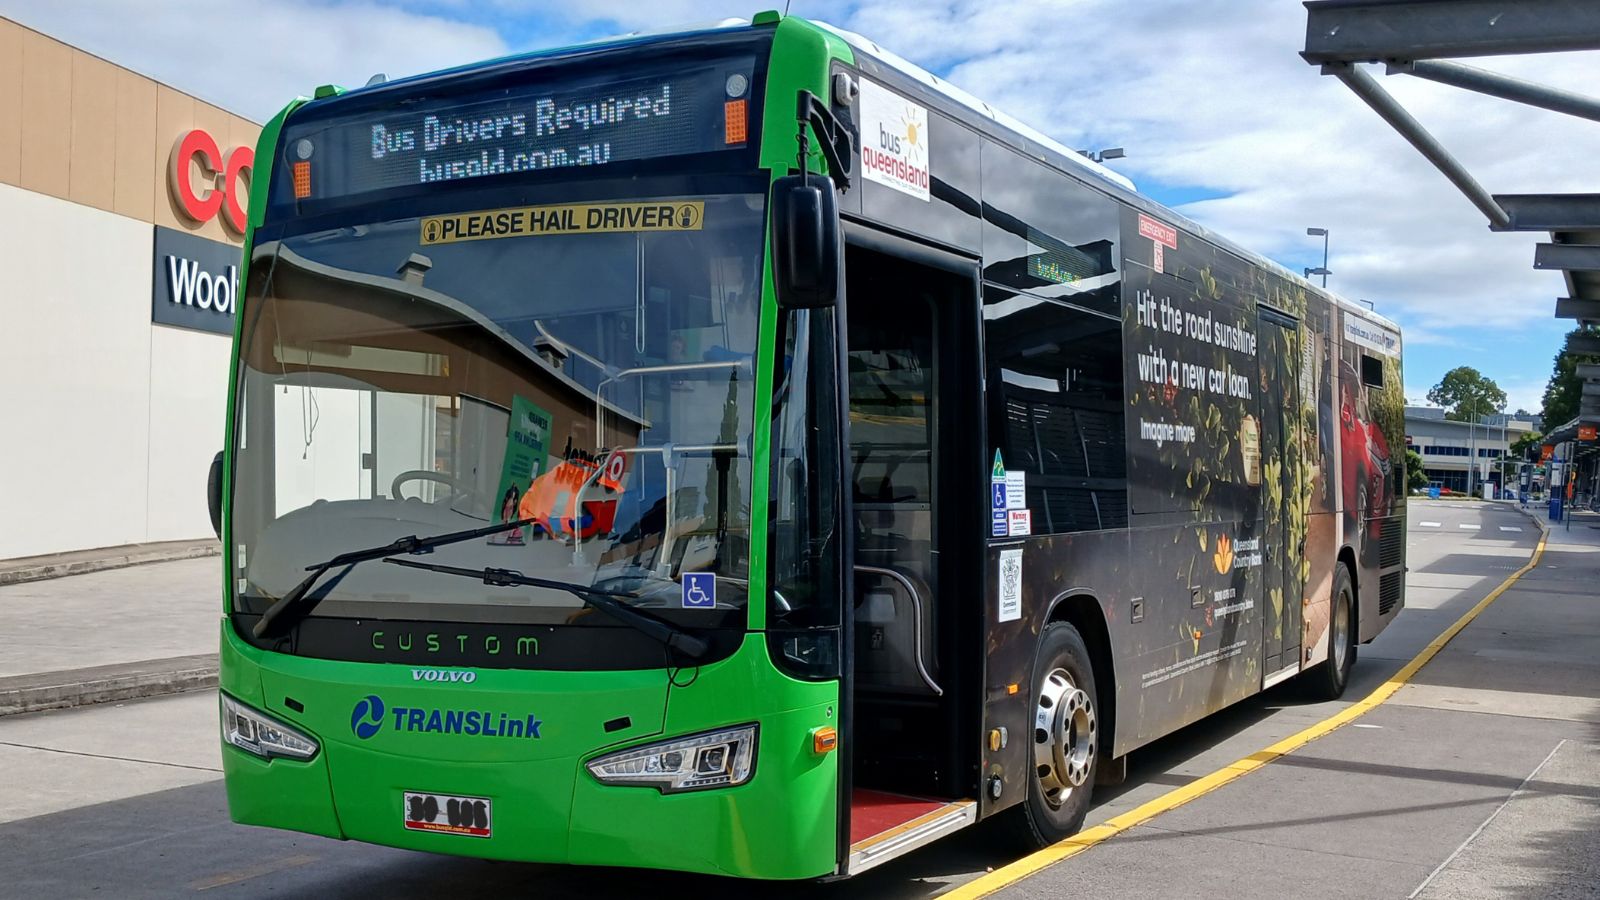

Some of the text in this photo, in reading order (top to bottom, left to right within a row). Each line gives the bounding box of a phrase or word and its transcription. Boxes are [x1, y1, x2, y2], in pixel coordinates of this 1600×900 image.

[372, 85, 670, 158] Bus Drivers Required
[880, 121, 901, 154] bus
[863, 146, 928, 189] queensland
[441, 206, 675, 240] PLEASE HAIL DRIVER
[1140, 220, 1175, 244] EMERGENCY EXIT
[168, 255, 239, 314] Wool
[1136, 289, 1256, 357] Hit the road sunshine
[1137, 345, 1252, 400] with a new car loan.
[1140, 417, 1196, 448] Imagine more
[372, 631, 539, 656] CUSTOM
[411, 669, 477, 683] VOLVO
[392, 707, 543, 739] TRANSLink
